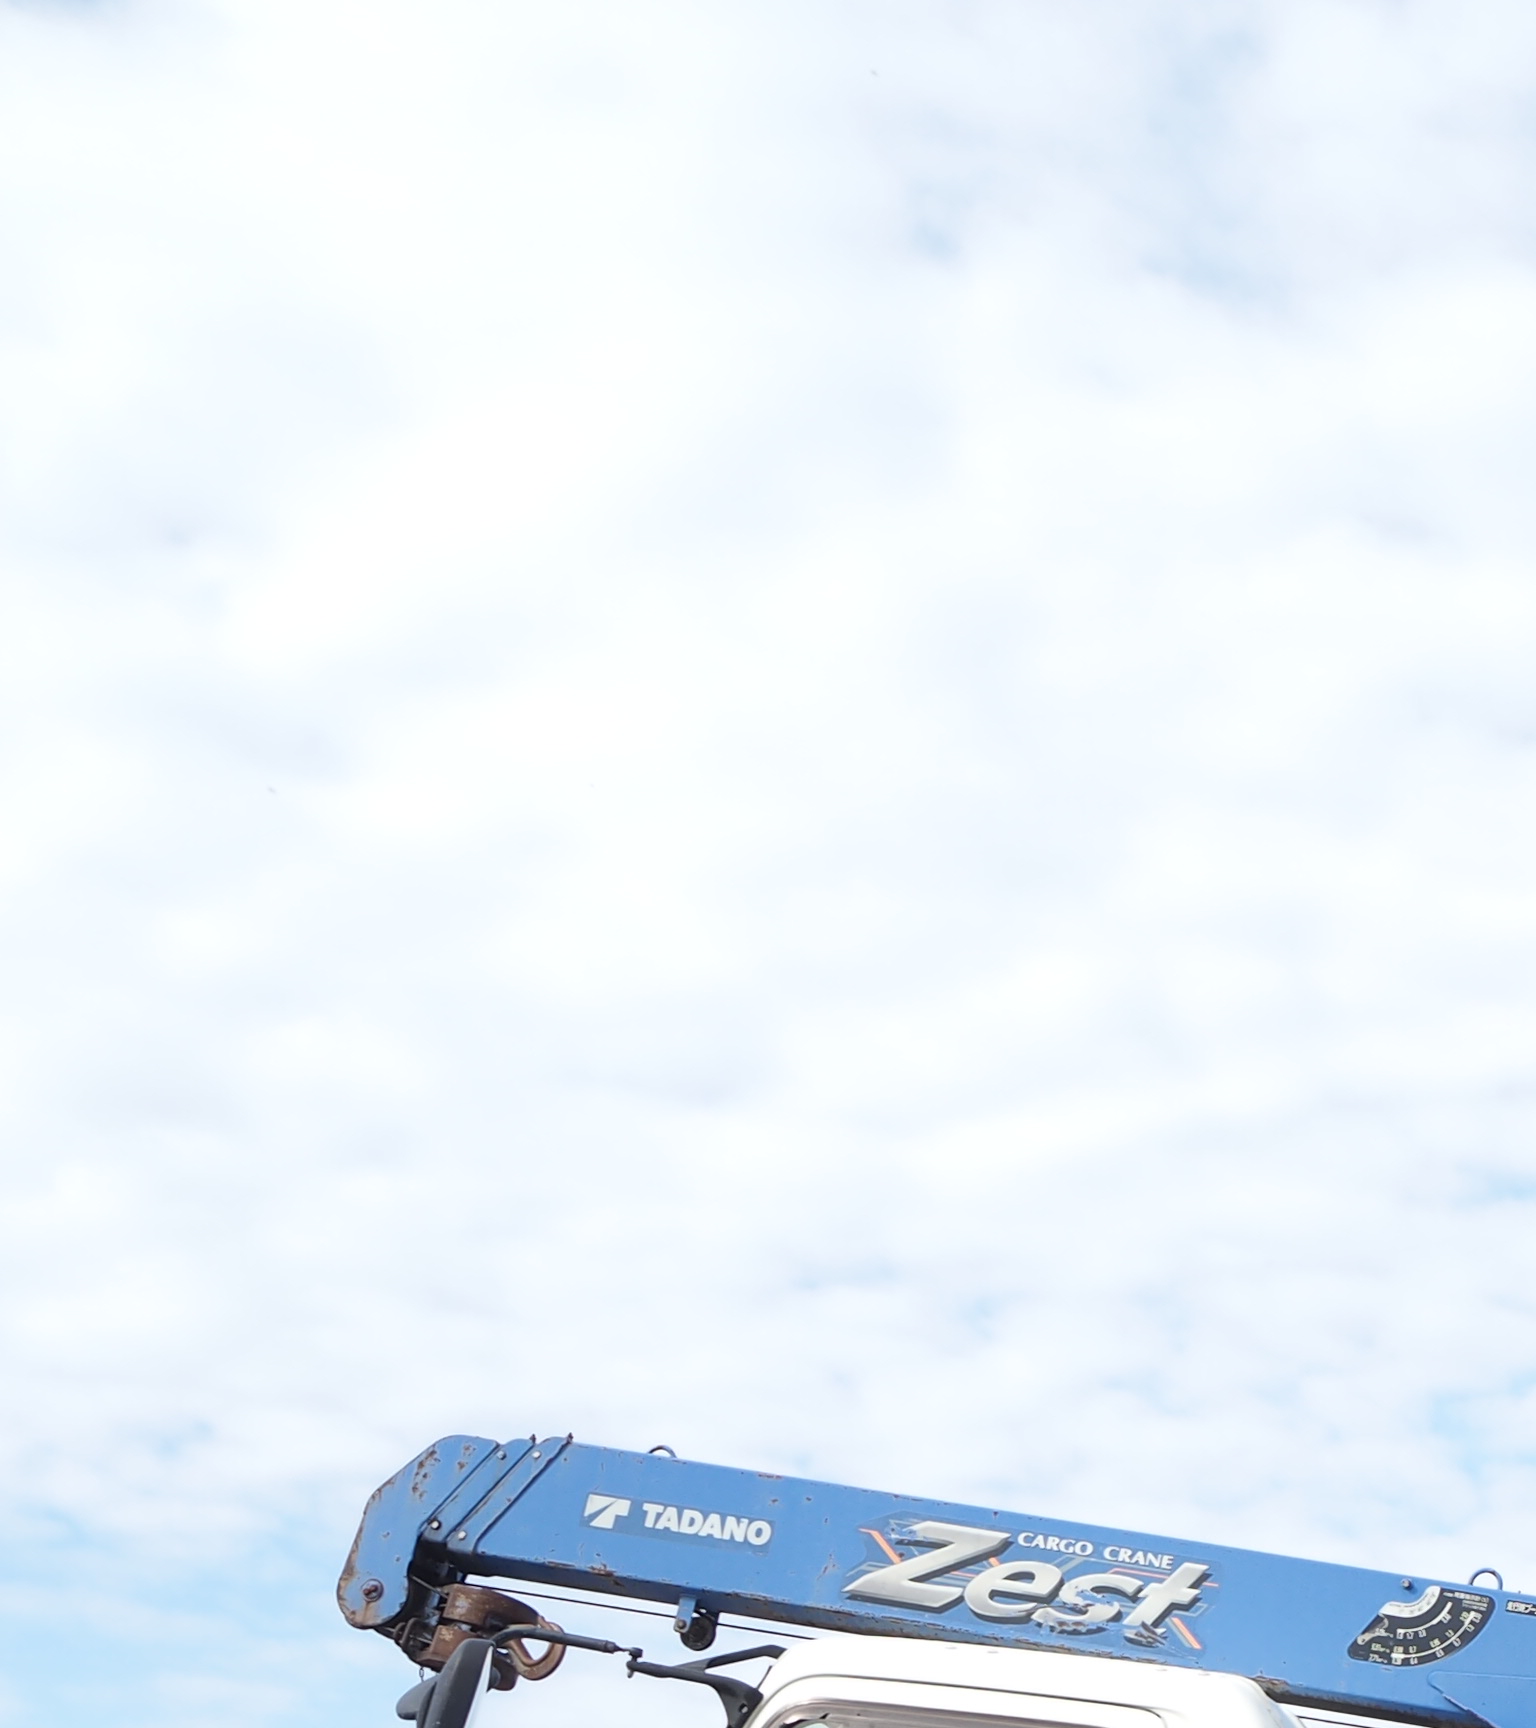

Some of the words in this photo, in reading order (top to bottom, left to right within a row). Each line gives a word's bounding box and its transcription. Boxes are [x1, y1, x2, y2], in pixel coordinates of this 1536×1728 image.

[642, 1502, 772, 1546] TADANO
[1017, 1531, 1094, 1556] CARGO
[1103, 1546, 1174, 1571] CRANE
[841, 1520, 1211, 1637] Zest
